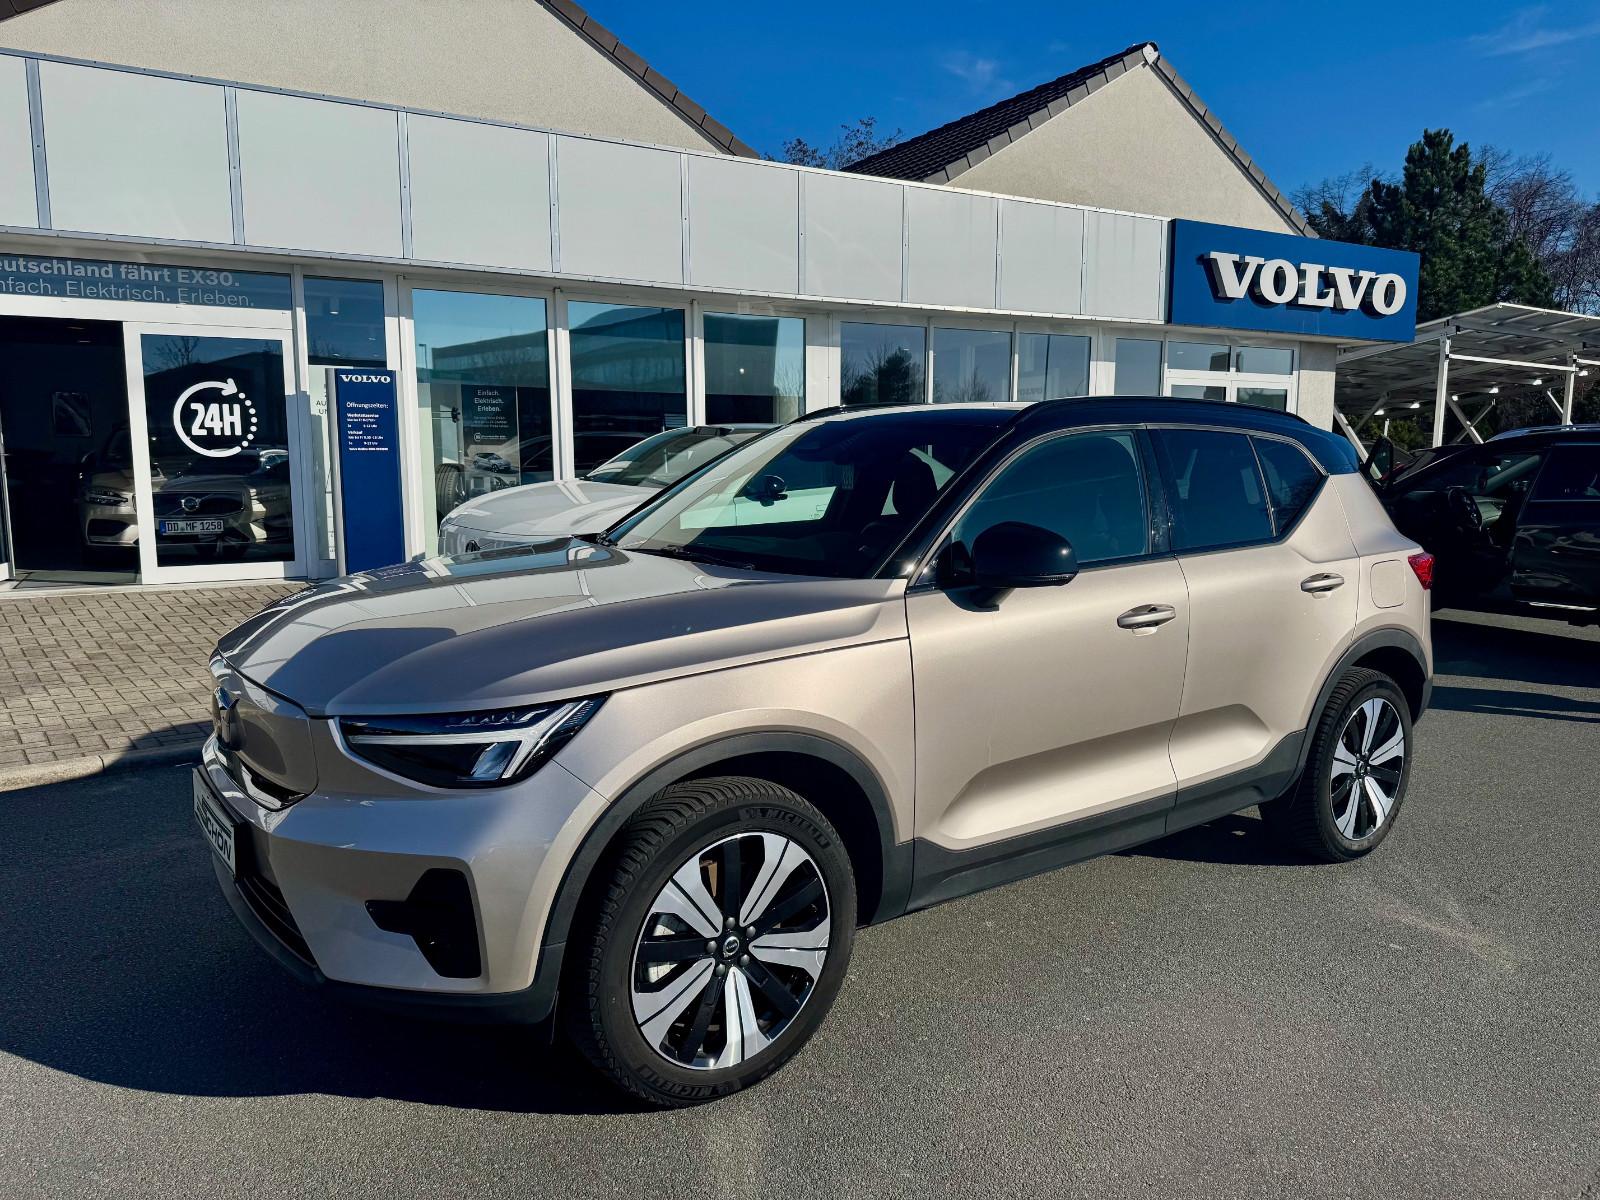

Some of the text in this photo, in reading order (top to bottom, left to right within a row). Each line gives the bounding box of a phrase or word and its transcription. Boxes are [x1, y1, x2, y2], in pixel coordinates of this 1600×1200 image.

[0, 257, 240, 288] utschland fährt EX30.
[1209, 251, 1407, 316] VOLVO
[0, 276, 255, 307] nfach. Elektrisch. Erleben.
[340, 374, 391, 384] VOLVO
[190, 402, 242, 436] 24H
[167, 520, 222, 532] DD MF 1258
